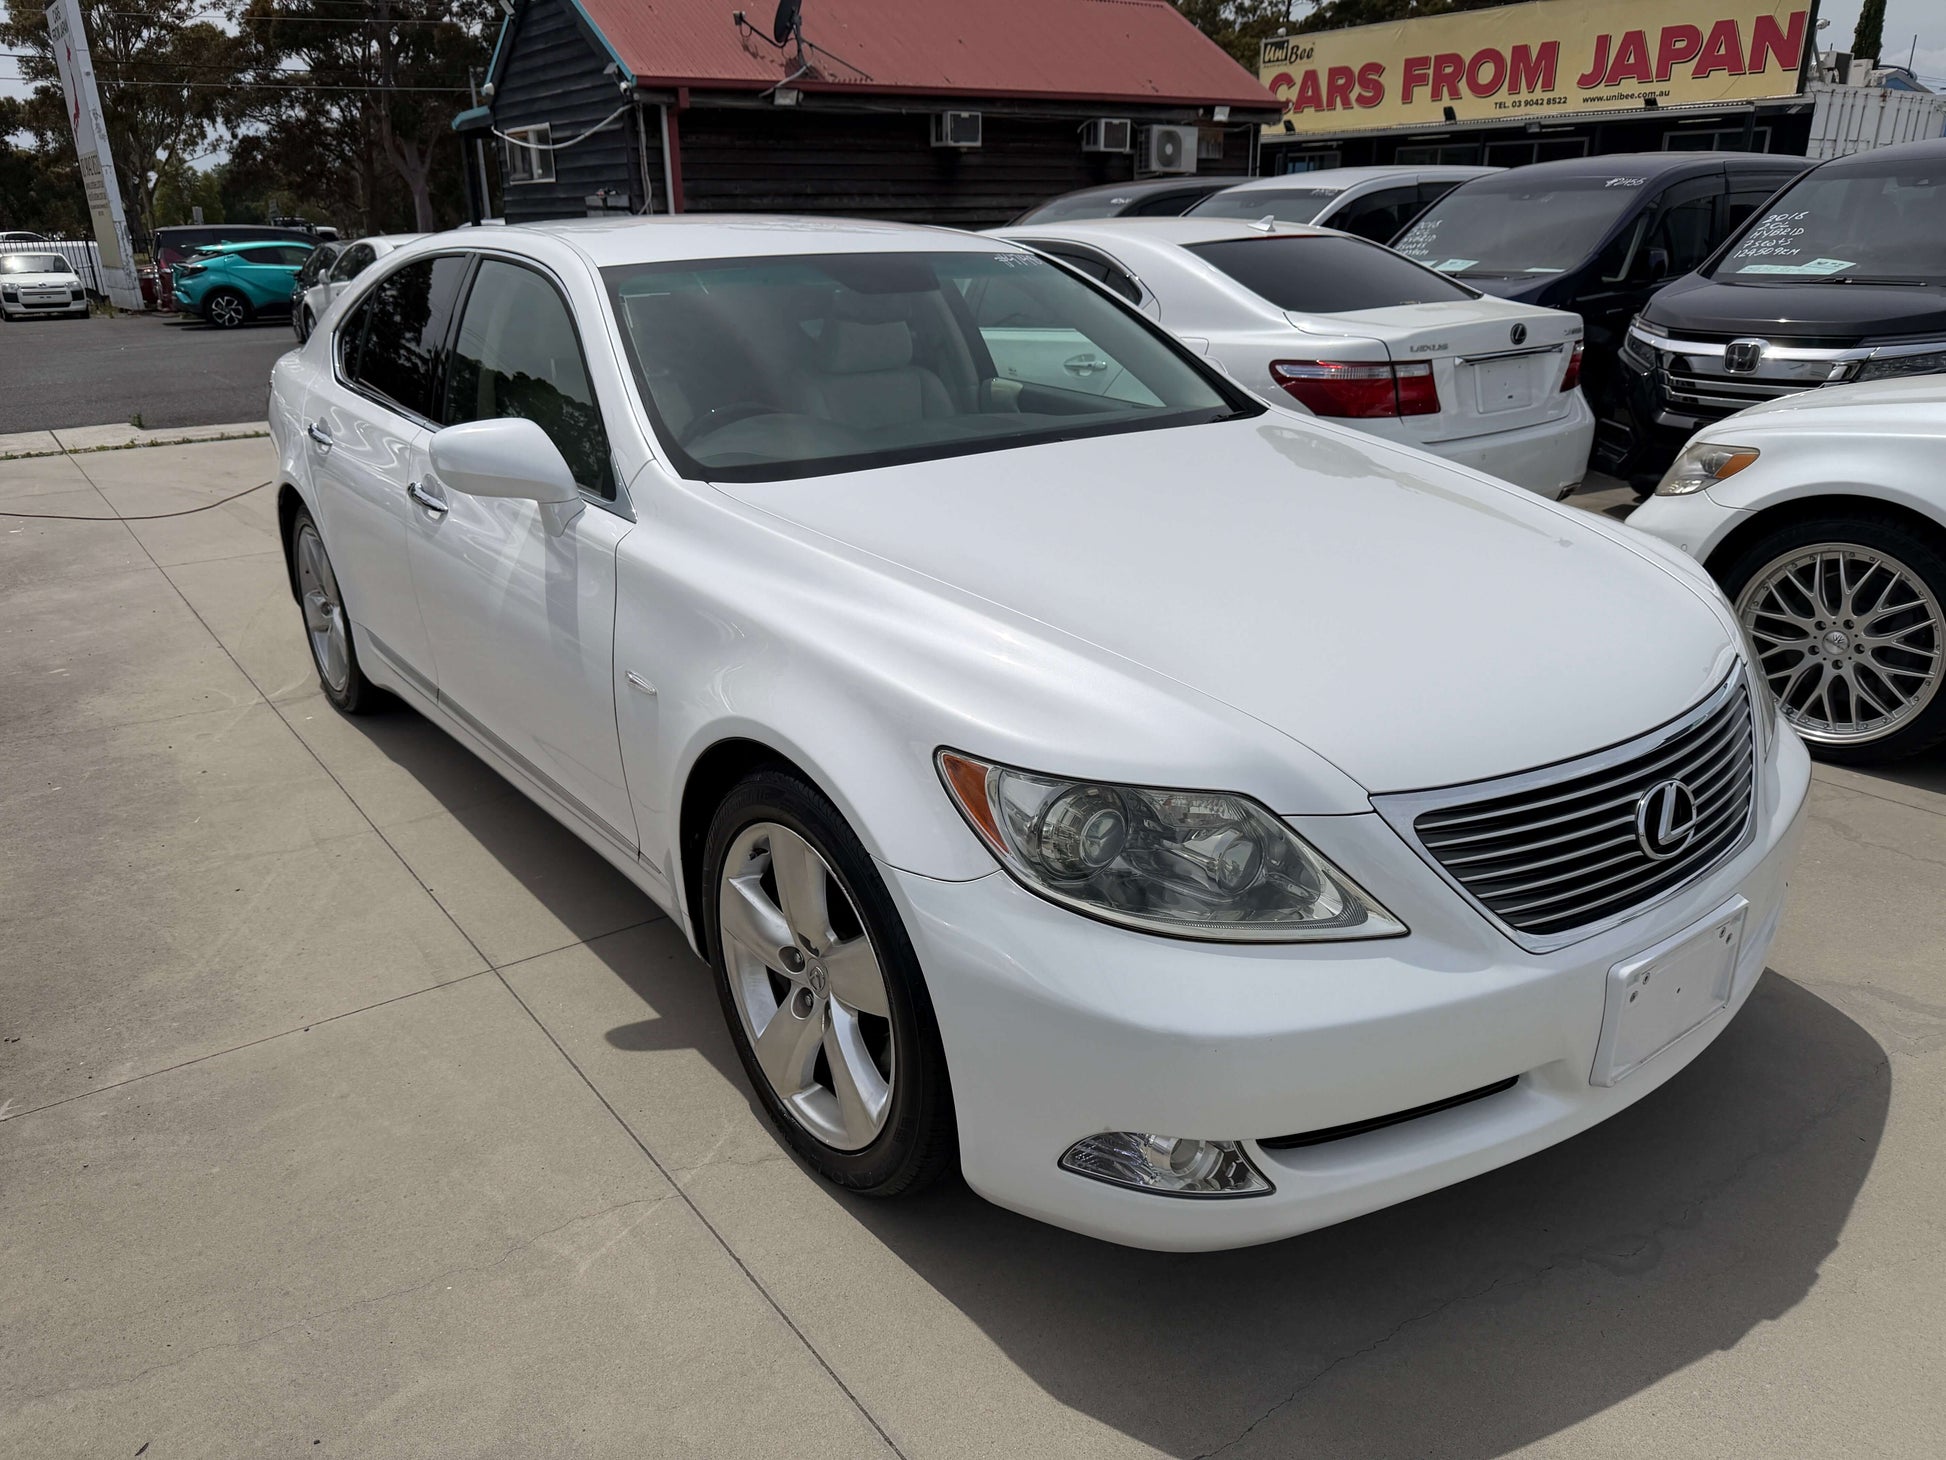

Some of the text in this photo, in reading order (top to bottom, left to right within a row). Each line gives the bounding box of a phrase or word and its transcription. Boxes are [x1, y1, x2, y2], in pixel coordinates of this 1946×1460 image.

[1268, 10, 1808, 113] CARS FROM JAPAN
[1511, 100, 1522, 109] 03
[1523, 98, 1545, 107] 9042
[1546, 96, 1568, 106] 8522
[1582, 90, 1671, 104] www.unibee.com.au
[1749, 227, 1805, 239] HYBRID
